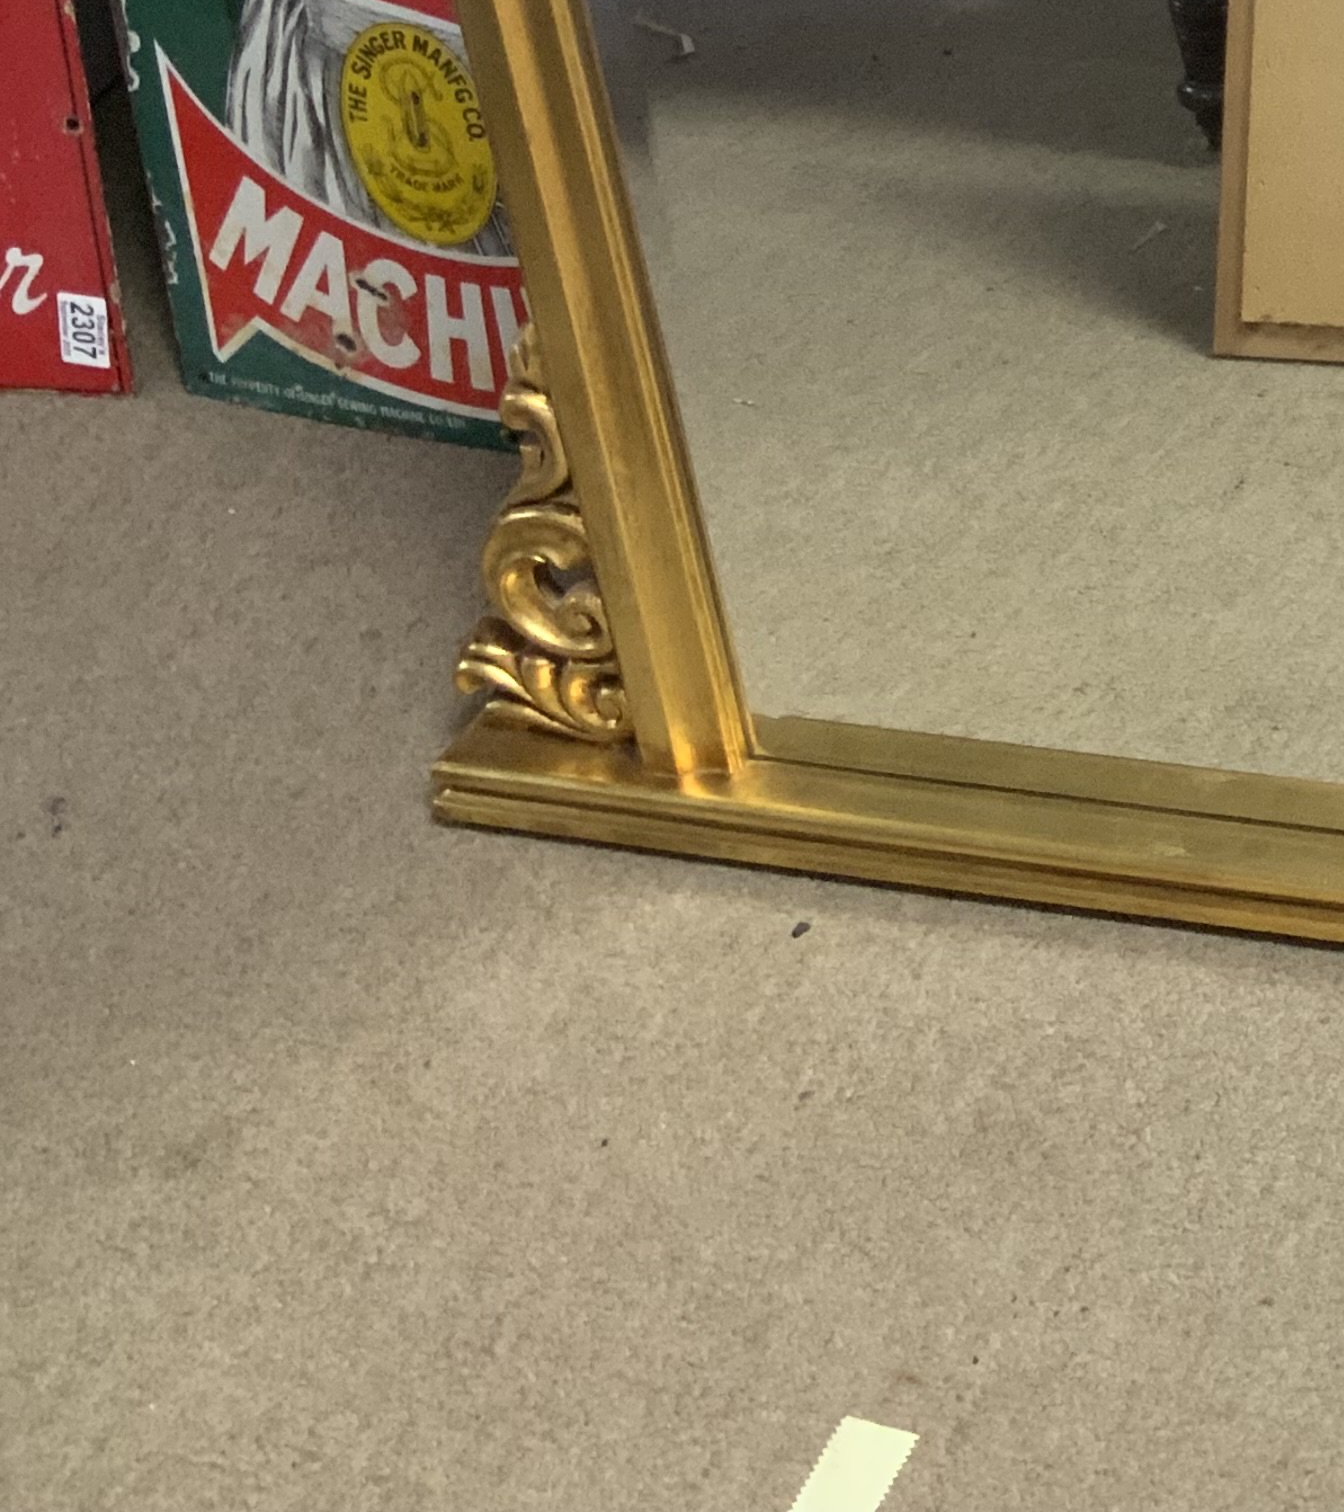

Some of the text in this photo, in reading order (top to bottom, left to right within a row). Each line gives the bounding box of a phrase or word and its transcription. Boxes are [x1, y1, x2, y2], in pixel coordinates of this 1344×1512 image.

[351, 30, 407, 80] SINGER
[348, 83, 369, 123] THE
[208, 176, 533, 393] MACHI
[69, 301, 97, 360] 2307
